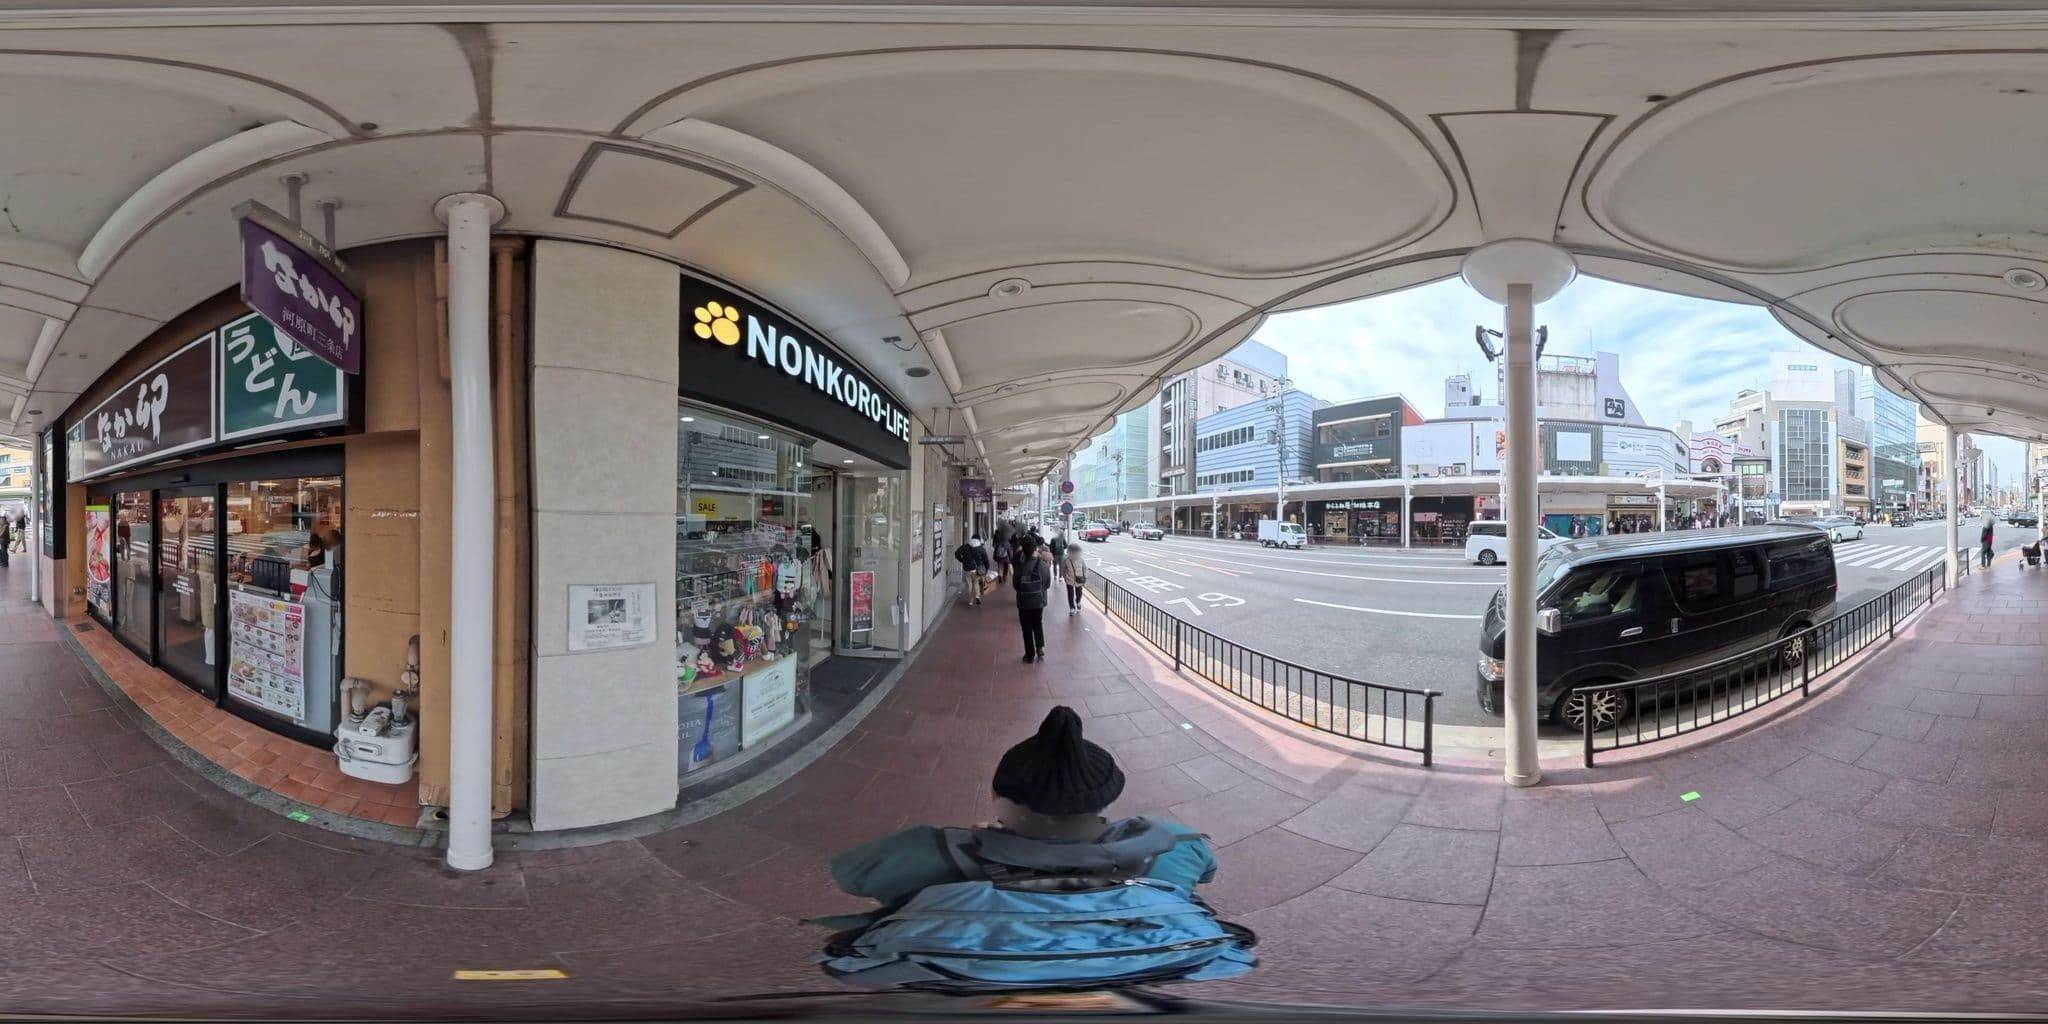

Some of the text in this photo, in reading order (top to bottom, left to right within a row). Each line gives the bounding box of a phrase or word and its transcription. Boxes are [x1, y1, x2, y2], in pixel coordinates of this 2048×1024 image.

[261, 240, 355, 352] なか卯
[282, 306, 343, 360] 河原町三条店
[227, 325, 318, 419] うどん
[747, 314, 910, 443] NONKORO-LIFE
[97, 373, 169, 453] なか卯
[111, 440, 144, 460] NAKAU
[698, 502, 716, 512] SALE
